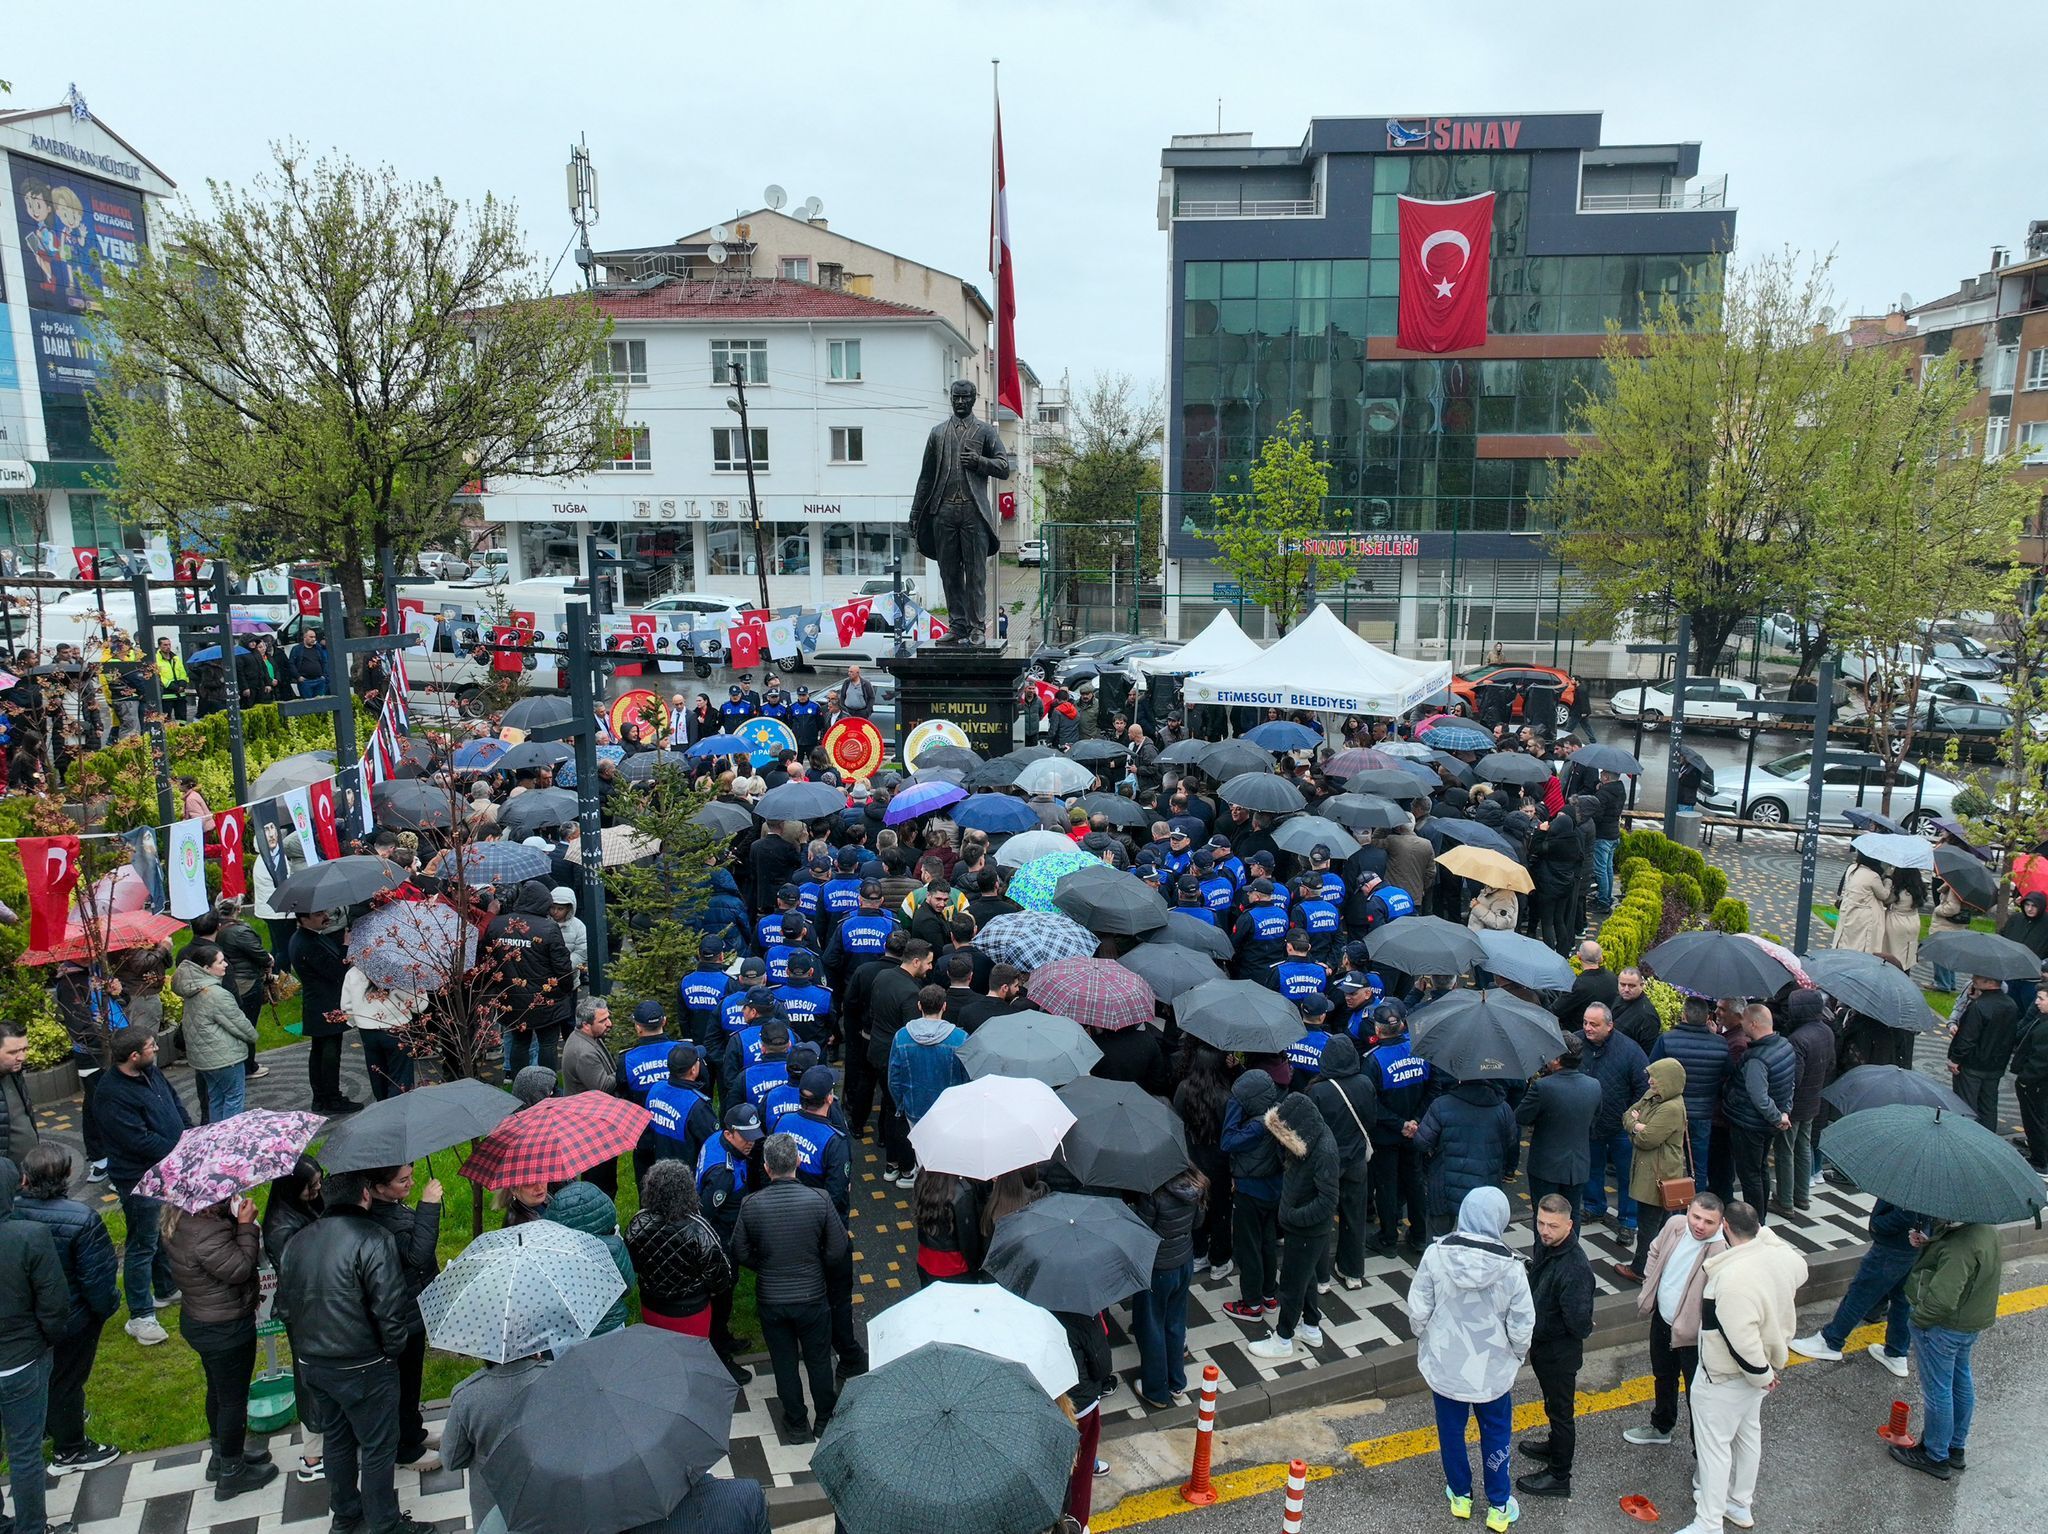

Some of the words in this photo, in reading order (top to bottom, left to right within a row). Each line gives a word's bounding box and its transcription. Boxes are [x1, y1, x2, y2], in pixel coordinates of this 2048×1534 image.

[1434, 118, 1521, 150] SINAV
[42, 335, 72, 358] DAHA
[552, 501, 587, 514] TUĞBA
[632, 500, 763, 518] ESLEM
[930, 702, 945, 714] NE
[948, 703, 987, 715] MUTLU
[1322, 892, 1340, 901] ABITA
[831, 899, 858, 907] ZABITA
[1312, 918, 1335, 928] ZABITA
[1261, 926, 1284, 936] ZABITA
[851, 938, 881, 947] ZABITA
[1289, 985, 1318, 994] ZABITA
[688, 996, 717, 1006] ZABITA
[788, 1013, 815, 1022] ABITA
[639, 1071, 671, 1086] ZABIT
[1393, 1067, 1424, 1083] ZABITA
